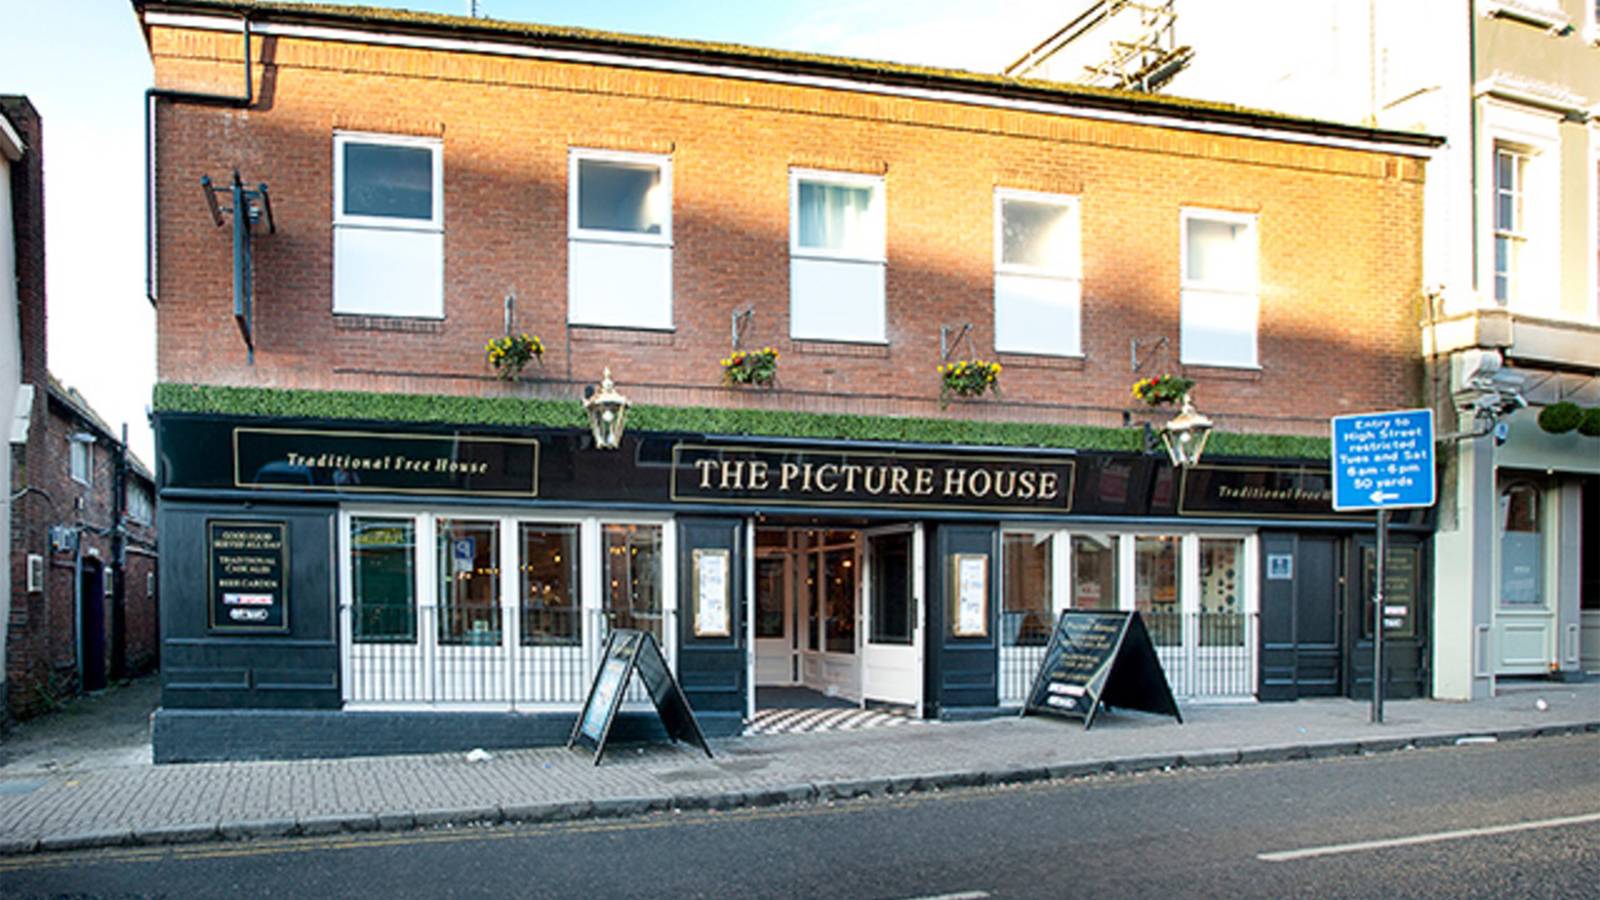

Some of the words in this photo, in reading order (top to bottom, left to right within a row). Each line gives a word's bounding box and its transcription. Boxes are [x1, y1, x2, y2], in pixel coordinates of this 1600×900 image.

[1355, 419, 1391, 430] Entry
[1394, 417, 1411, 427] to
[1344, 431, 1376, 443] High
[1379, 427, 1423, 439] Street
[1349, 439, 1417, 452] restricted
[287, 452, 390, 470] Traditional
[394, 456, 431, 471] Free
[434, 458, 488, 474] House
[1340, 453, 1370, 464] Tues
[1374, 451, 1399, 462] and
[1403, 449, 1428, 460] Sat
[694, 458, 769, 491] THE
[777, 462, 935, 496] PICTURE
[943, 467, 1059, 500] HOUSE
[1354, 478, 1374, 490] 50
[1376, 476, 1414, 489] yards
[1218, 485, 1292, 499] Traditional
